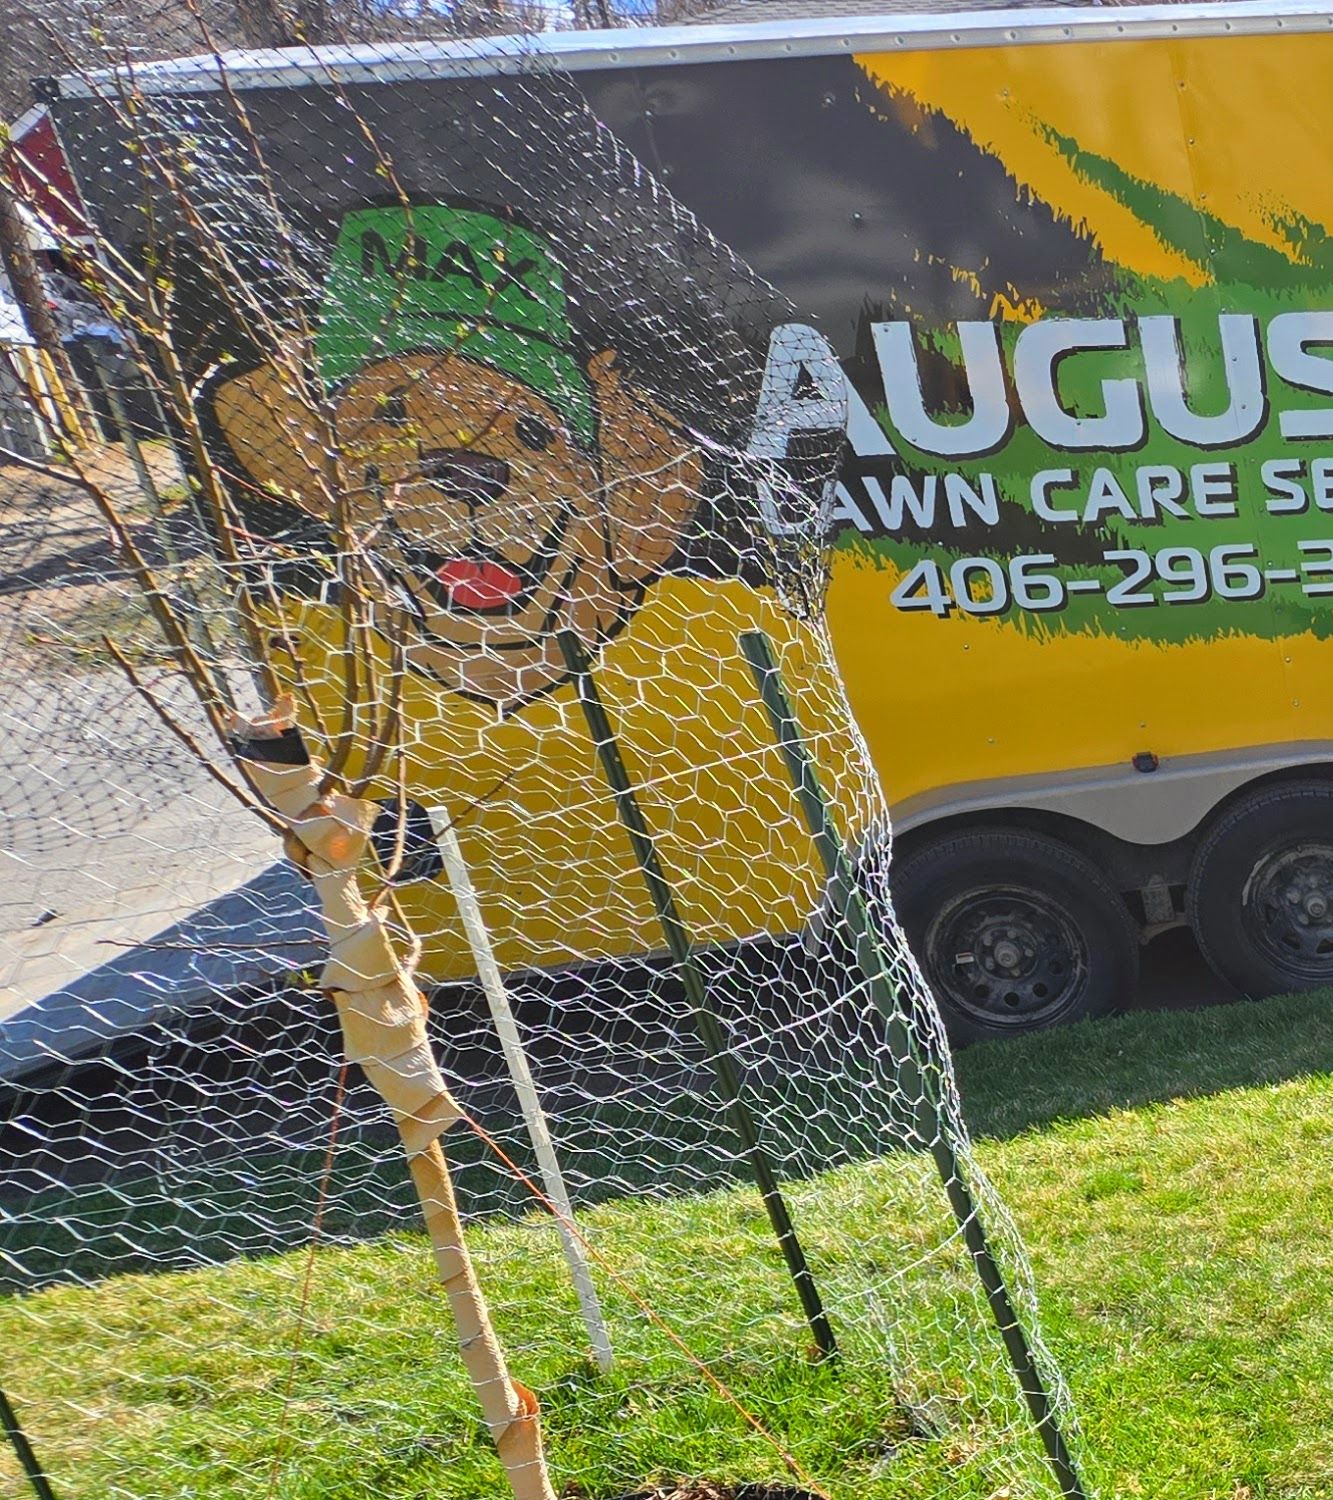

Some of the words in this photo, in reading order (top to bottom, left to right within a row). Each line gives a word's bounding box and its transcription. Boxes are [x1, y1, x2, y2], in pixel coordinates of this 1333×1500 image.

[361, 228, 540, 305] MAX
[756, 472, 1001, 536] LAWN
[1030, 460, 1238, 525] CARE
